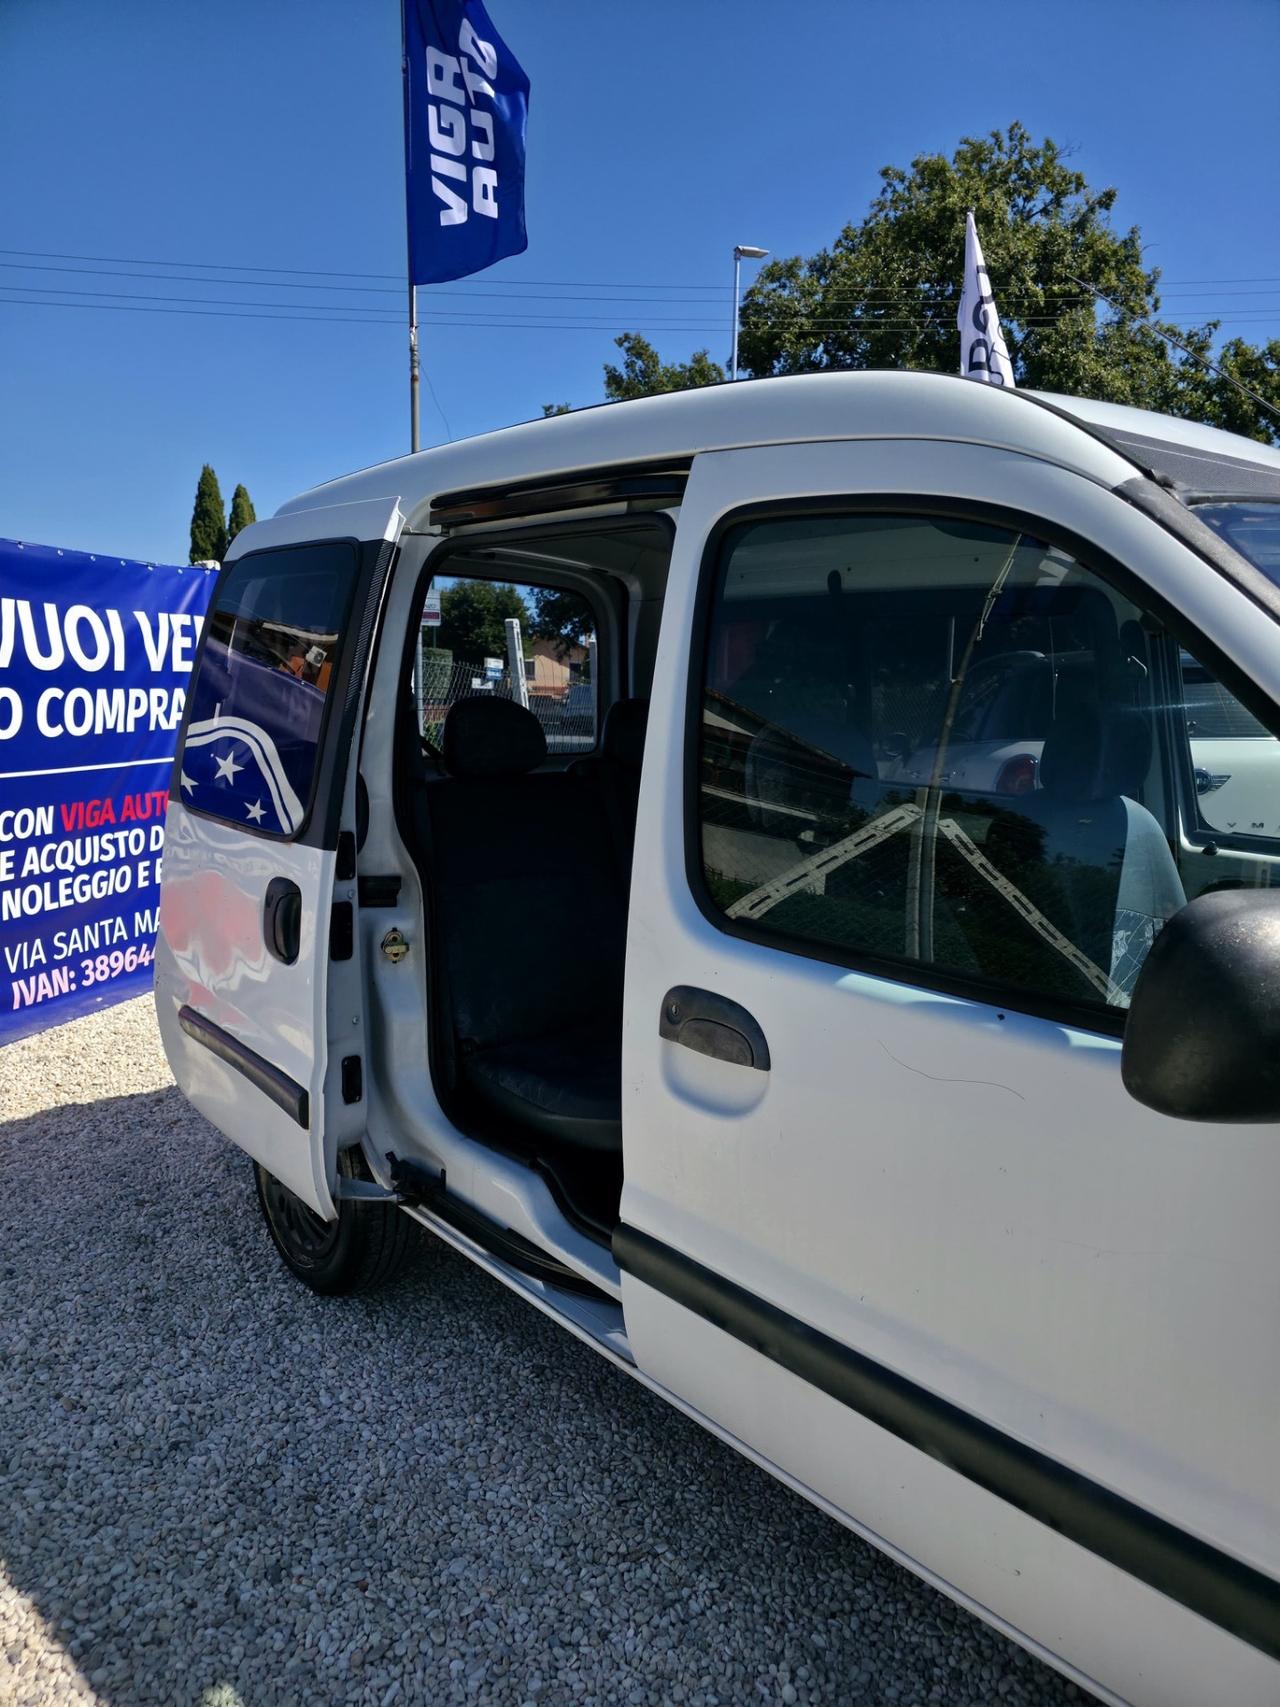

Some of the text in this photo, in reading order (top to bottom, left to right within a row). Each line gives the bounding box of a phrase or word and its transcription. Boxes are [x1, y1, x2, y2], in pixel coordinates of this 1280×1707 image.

[426, 46, 468, 226] VIGA
[459, 18, 498, 219] AUTO
[0, 805, 54, 842] CON
[60, 799, 116, 832] VIGA
[0, 850, 15, 882] E
[20, 828, 146, 878] ACQUISTO
[2, 865, 132, 921] NOLEGGIO
[137, 861, 150, 888] E
[4, 938, 47, 974] VIA
[53, 916, 128, 960] SANTA
[11, 965, 77, 1010] IVAN:
